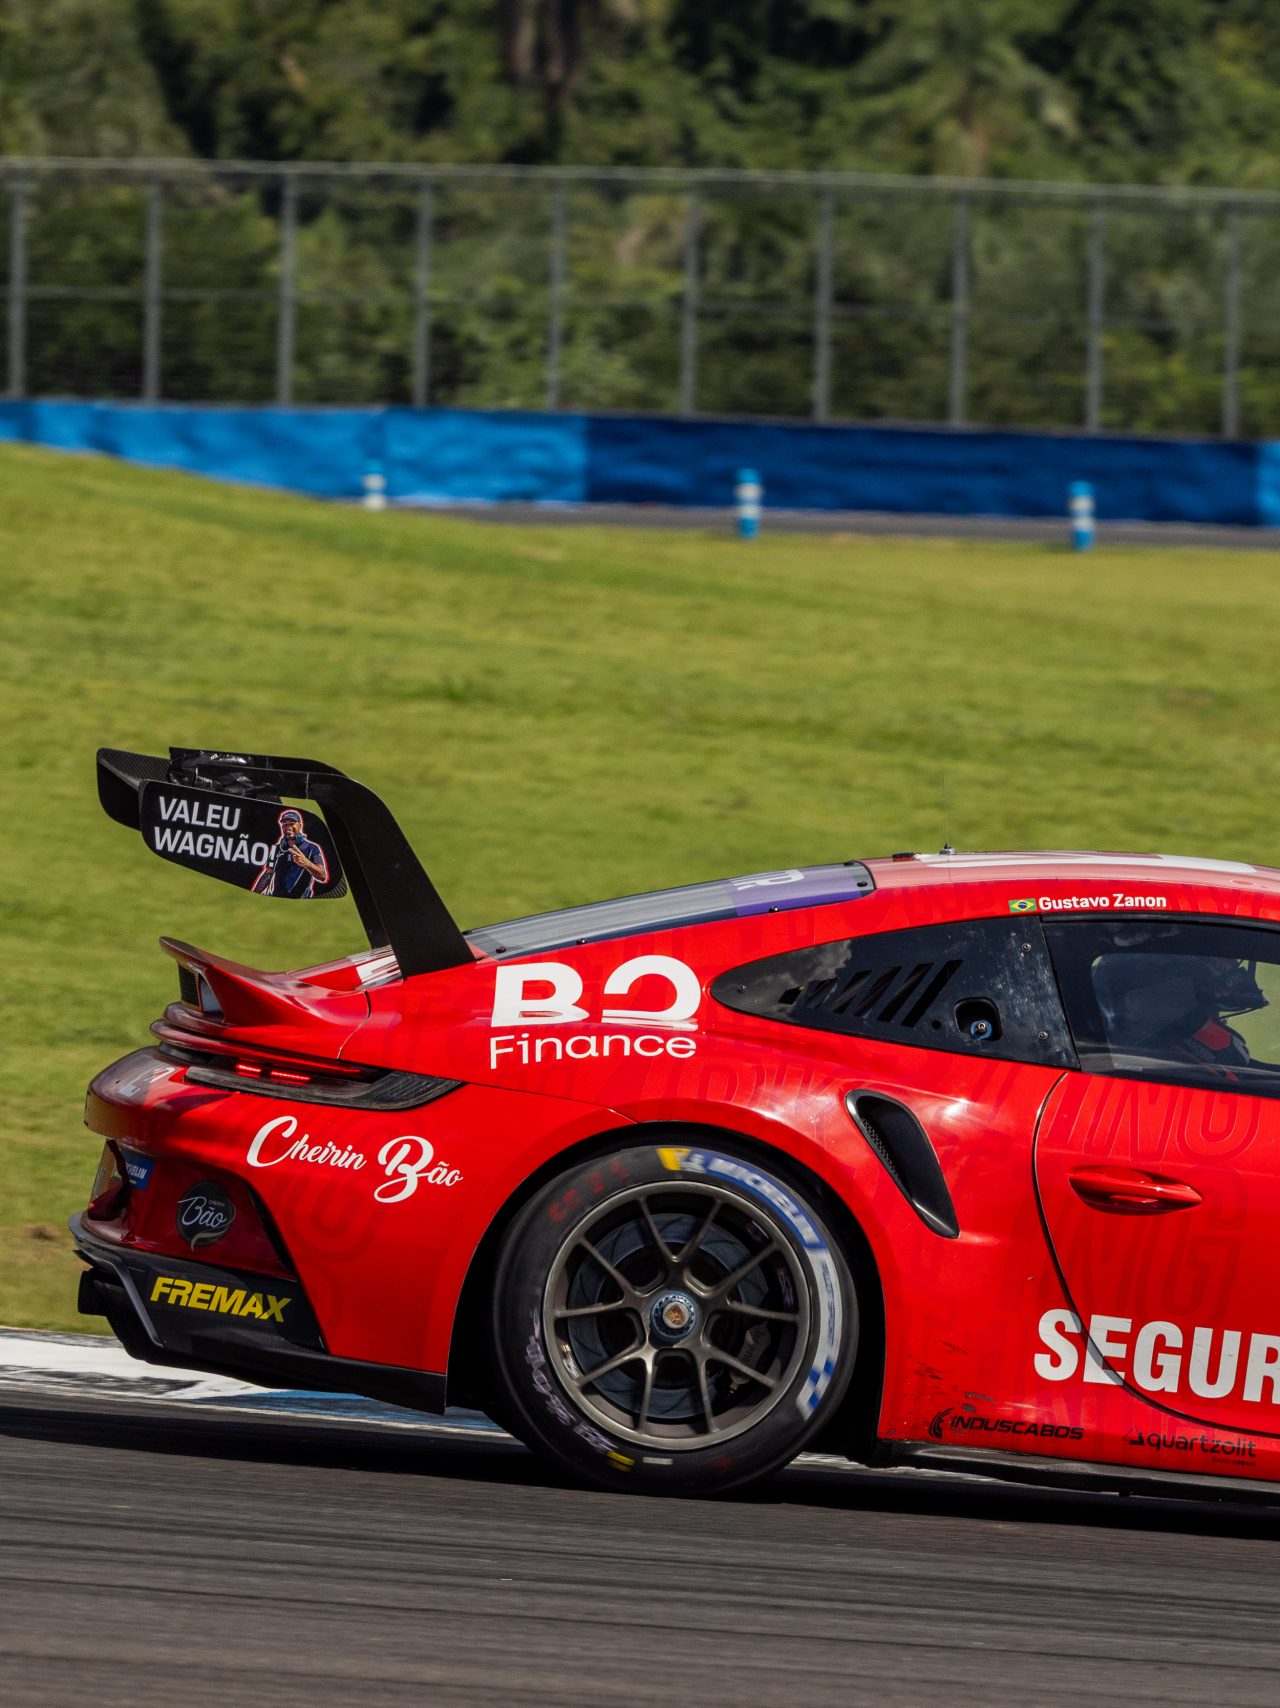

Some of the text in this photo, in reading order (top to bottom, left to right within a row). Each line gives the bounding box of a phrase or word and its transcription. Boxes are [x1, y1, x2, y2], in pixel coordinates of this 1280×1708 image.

[159, 796, 241, 831] VALEU
[154, 826, 277, 868] WAGNÃO!
[1038, 893, 1167, 911] Gustavo Zanon
[490, 1033, 697, 1070] Finance
[246, 1115, 463, 1203] Cheirin Bão
[177, 1196, 227, 1228] Bão
[150, 1276, 292, 1323] FREMAX
[1147, 1432, 1257, 1458] quartzolit
